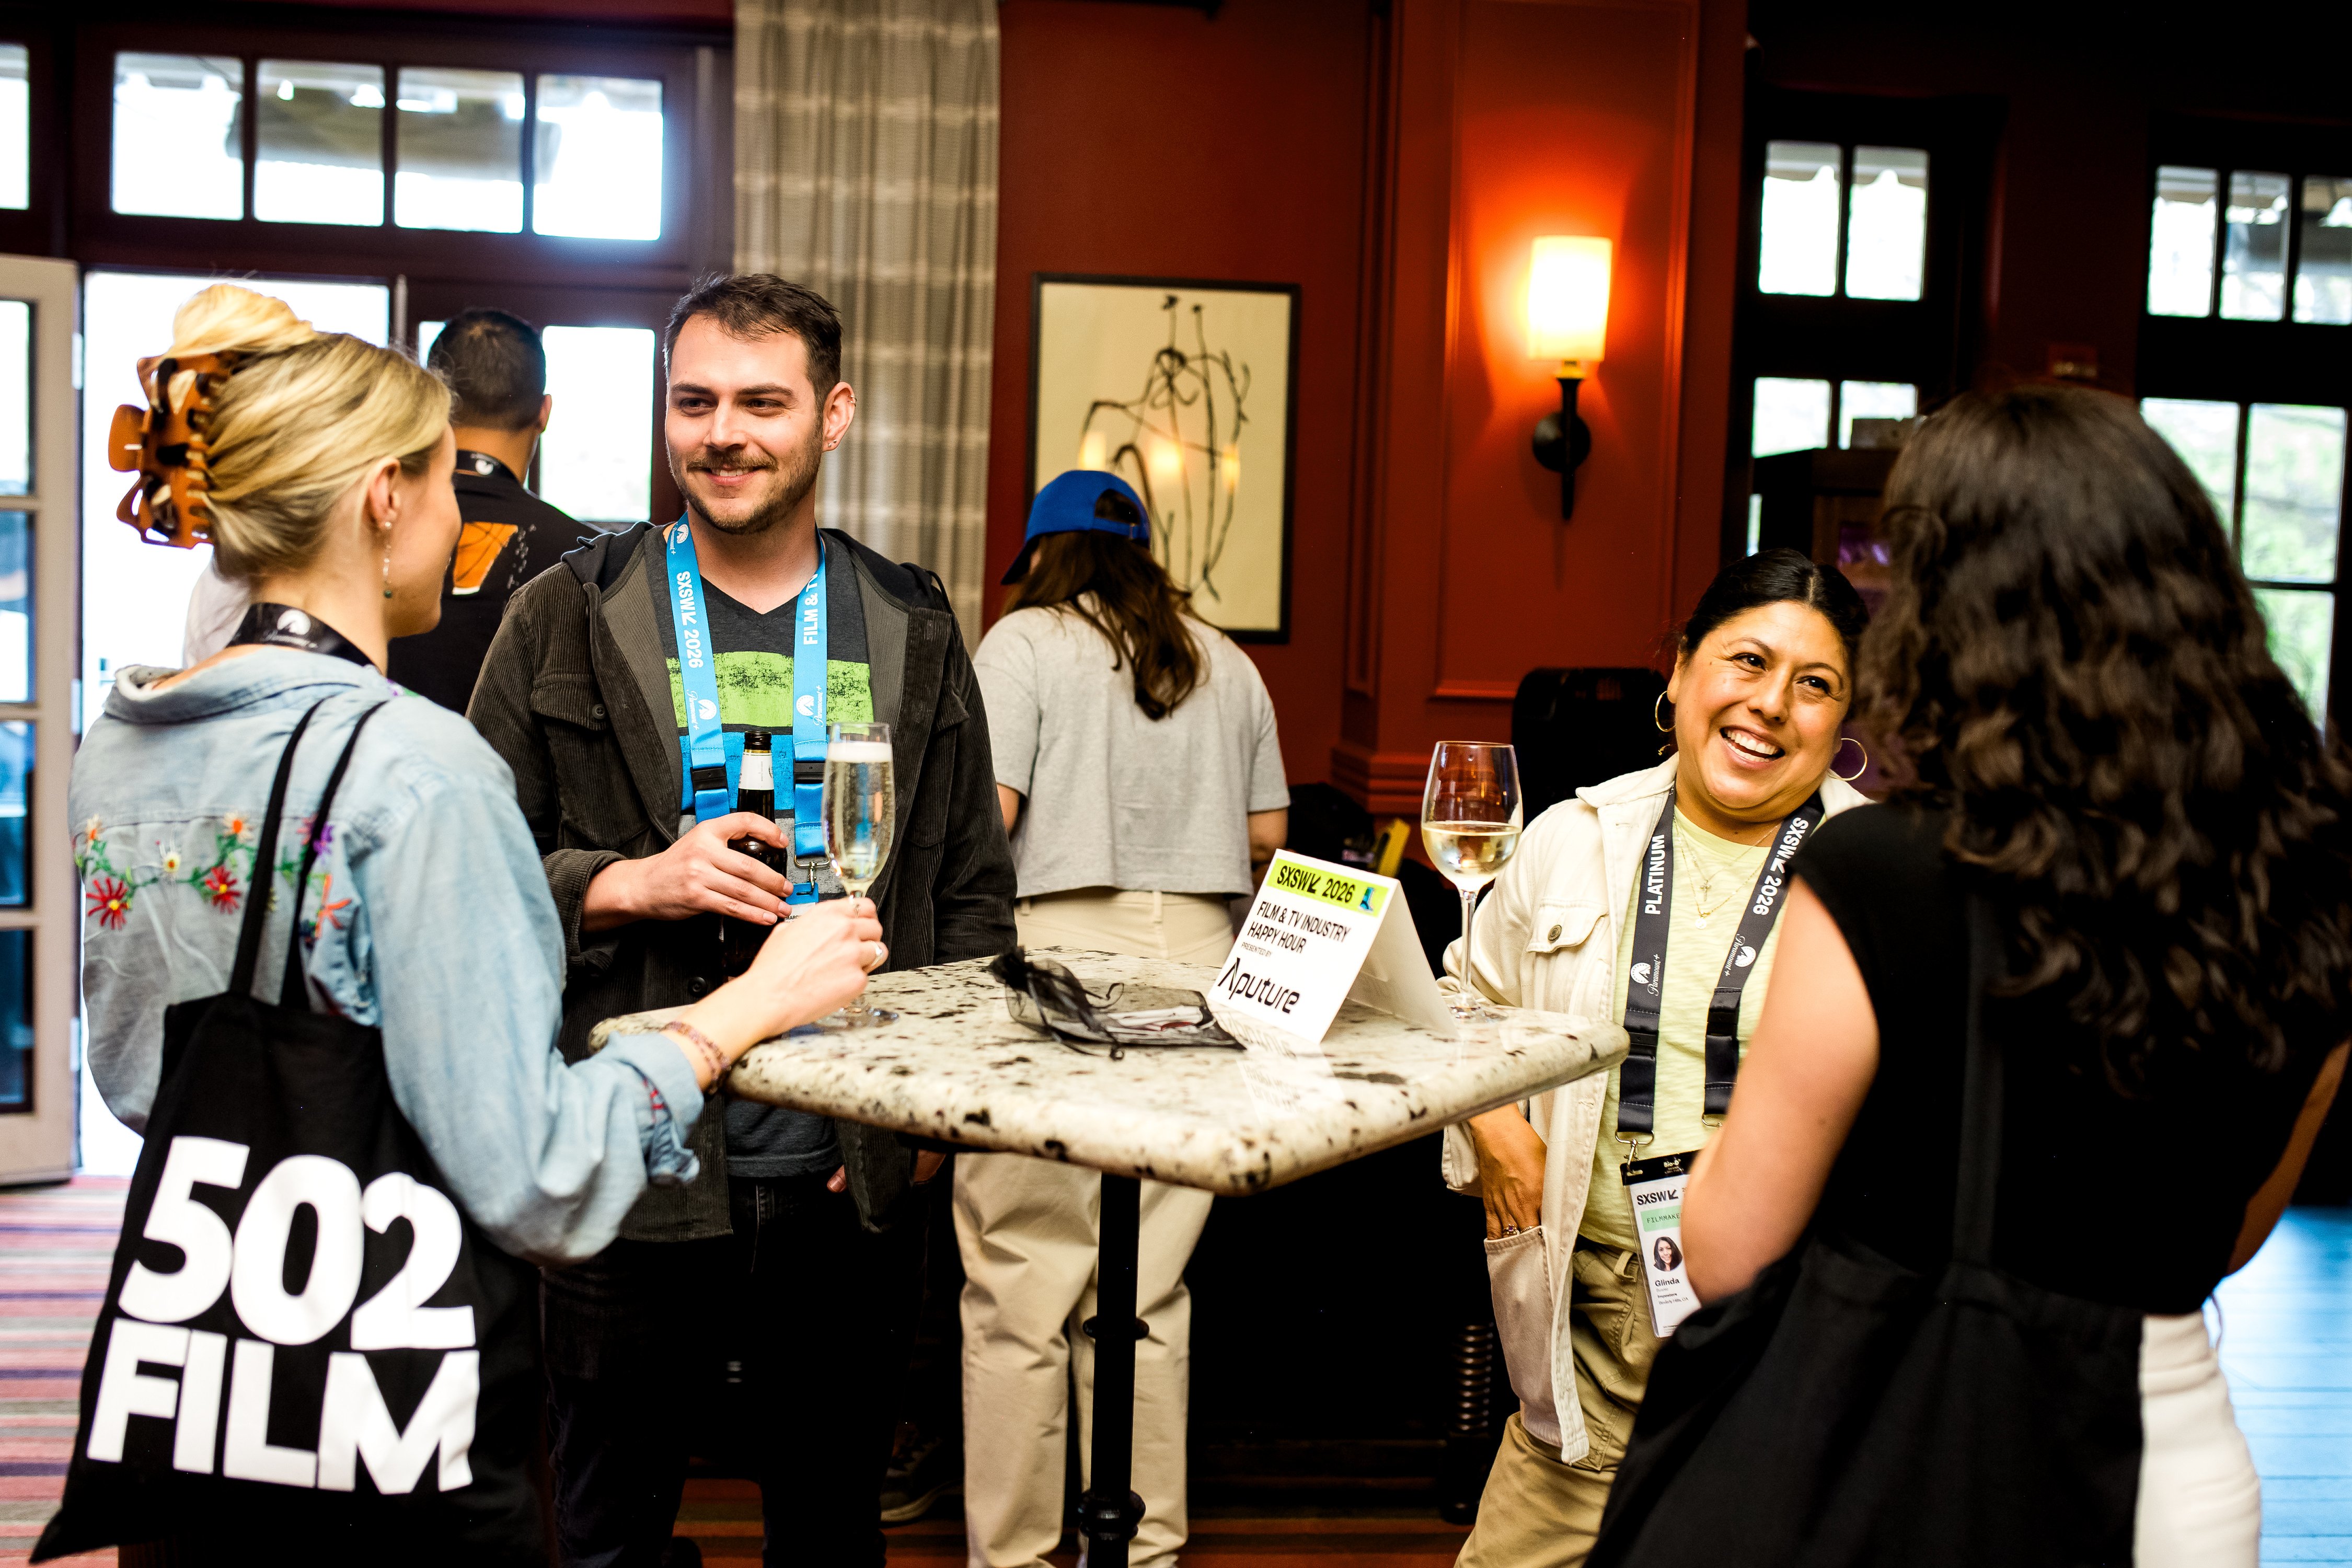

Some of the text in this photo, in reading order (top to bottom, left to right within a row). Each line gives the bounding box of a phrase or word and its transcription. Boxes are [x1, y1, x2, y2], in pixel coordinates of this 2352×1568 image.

[804, 593, 818, 606] &
[676, 571, 704, 668] SXSW 2026
[803, 608, 818, 645] FILM
[1277, 865, 1355, 903] SXSW 2026
[1644, 834, 1666, 915] PLATINUM
[1753, 817, 1809, 915] SXSW 2026
[1247, 921, 1307, 953] HAPPY HOUR
[1256, 901, 1352, 942] FILM & TV INDUSTRY
[1241, 942, 1266, 956] PRESENTED
[1217, 957, 1300, 1014] Aputure
[1636, 1191, 1667, 1205] SXSW
[1646, 1213, 1681, 1224] FILMMAKE
[118, 1135, 477, 1351] 502
[1655, 1278, 1680, 1287] Glinda
[86, 1318, 480, 1494] FILM
